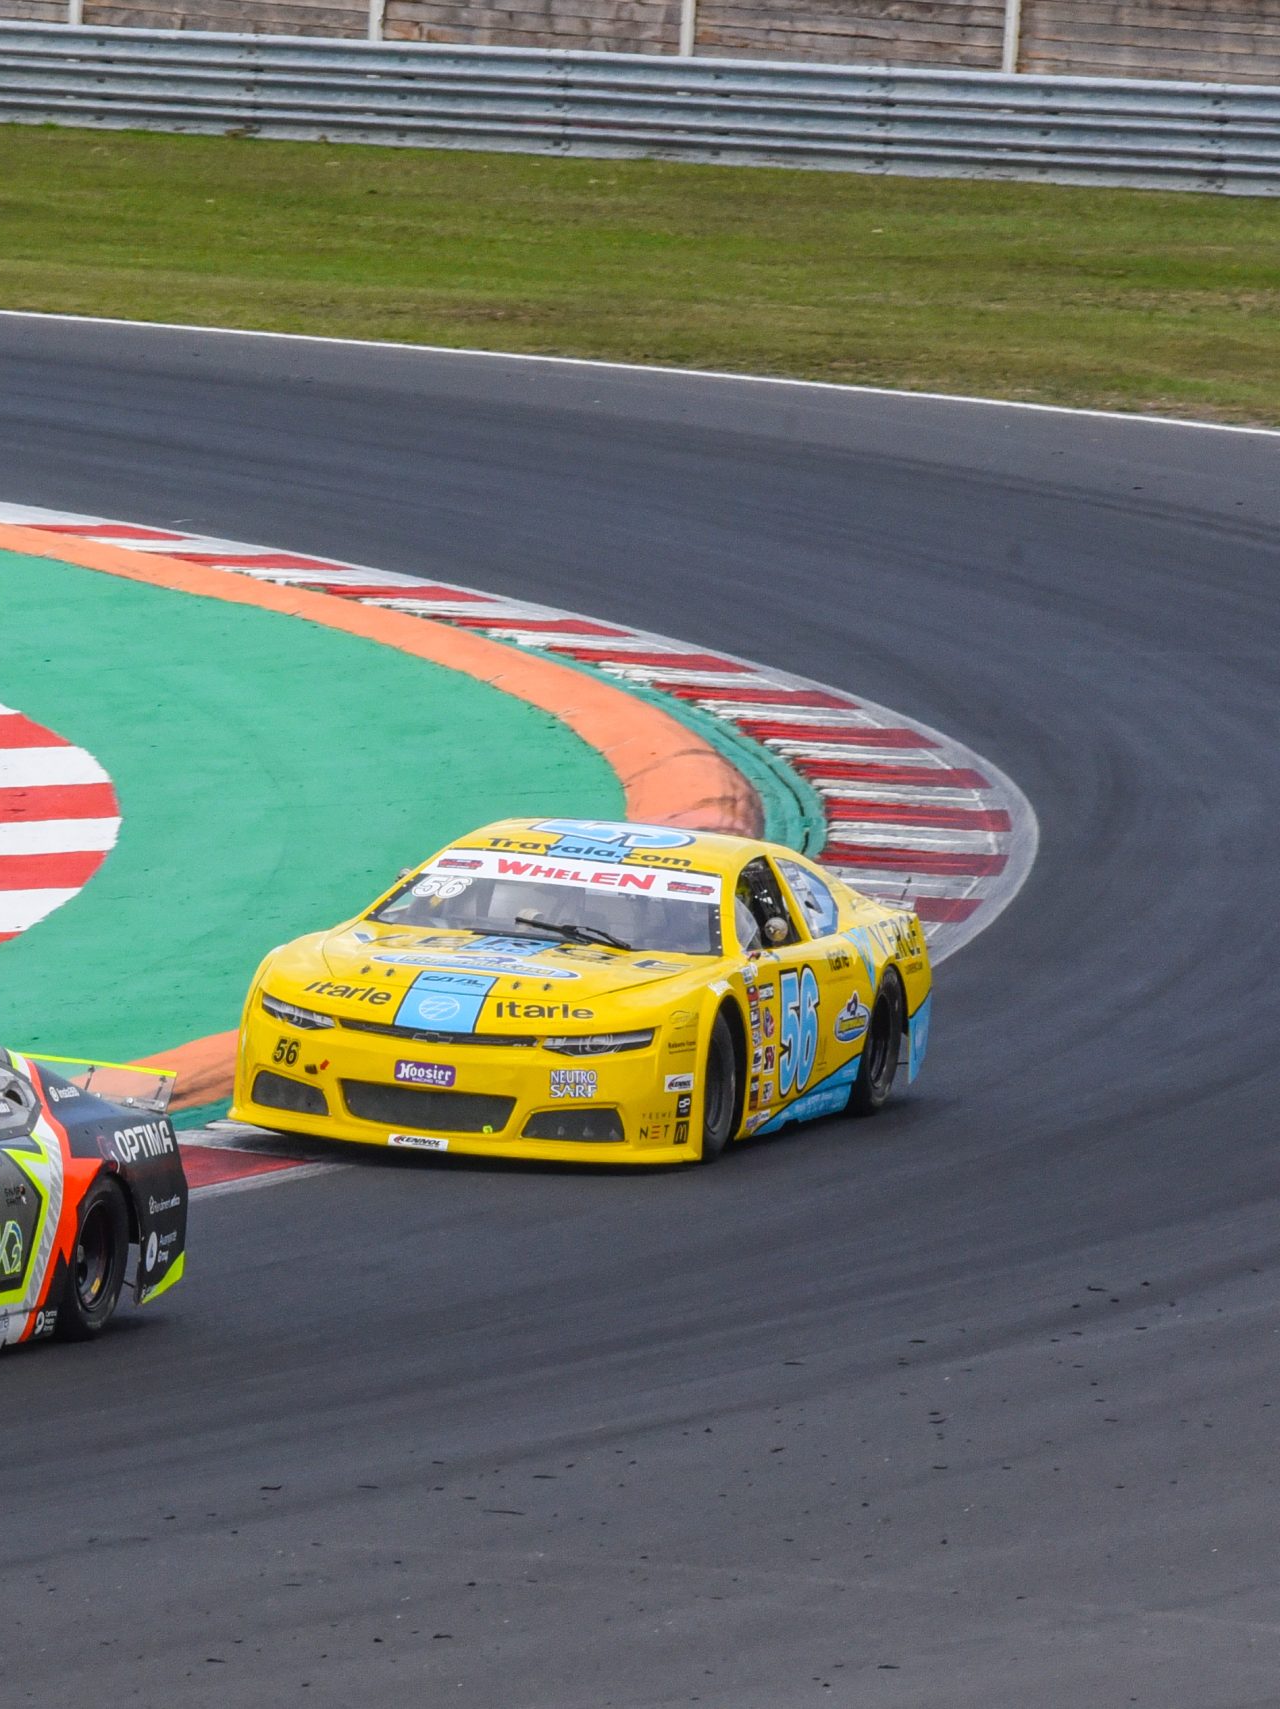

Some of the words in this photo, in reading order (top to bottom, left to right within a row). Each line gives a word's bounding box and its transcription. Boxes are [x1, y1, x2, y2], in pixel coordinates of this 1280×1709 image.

[487, 837, 693, 868] Travala.com
[411, 873, 473, 900] 56
[496, 858, 656, 890] WHELEN
[303, 980, 393, 1006] Itarle
[495, 1000, 595, 1020] Itarle
[778, 962, 820, 1099] 56
[272, 1036, 301, 1067] 56
[396, 1062, 452, 1081] Hoosier
[549, 1068, 598, 1086] NEUTRO
[549, 1083, 598, 1099] SARF
[113, 1120, 175, 1164] OPTIMA
[397, 1136, 442, 1146] KENNOL
[639, 1123, 671, 1140] NET
